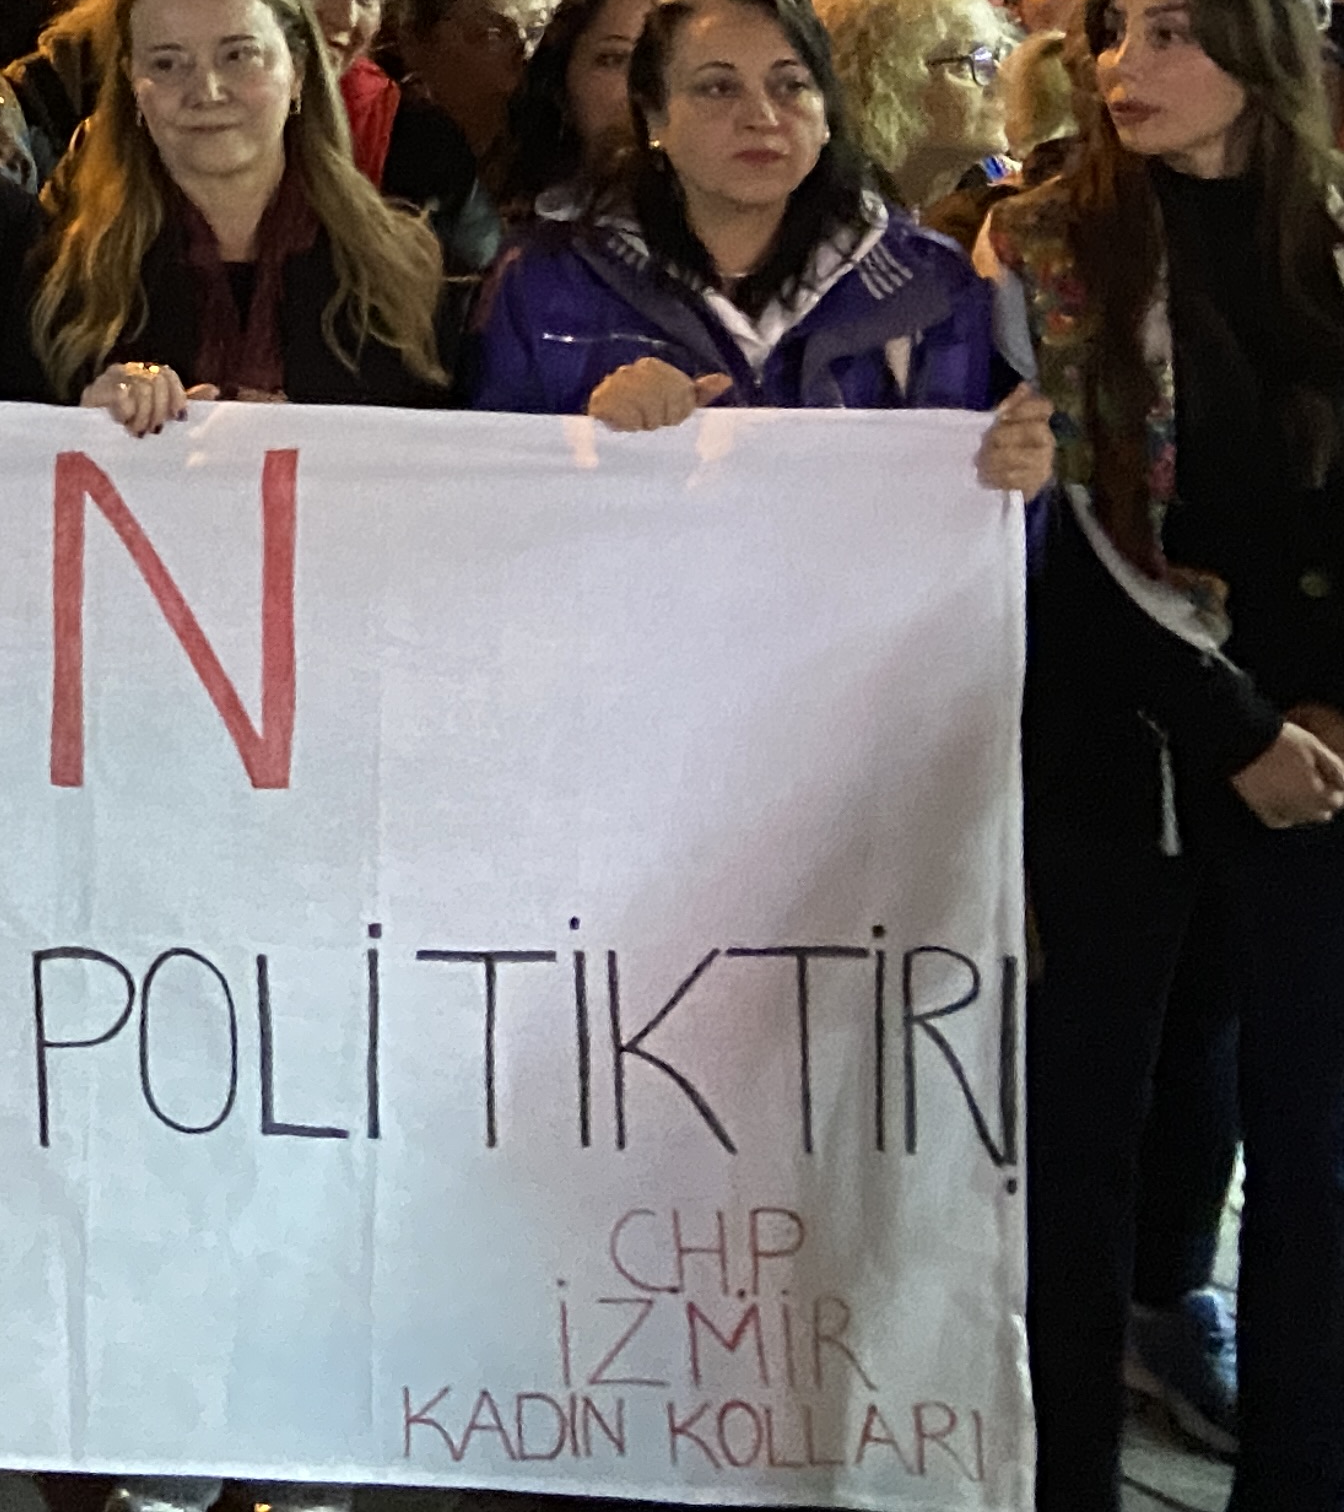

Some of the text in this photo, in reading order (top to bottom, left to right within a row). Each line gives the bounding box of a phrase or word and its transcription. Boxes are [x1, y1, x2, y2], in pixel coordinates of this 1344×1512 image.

[32, 916, 1020, 1195] POLİTİKTİR!
[555, 1279, 878, 1391] İZMİR
[402, 1385, 984, 1482] KADIN KOLLARI
